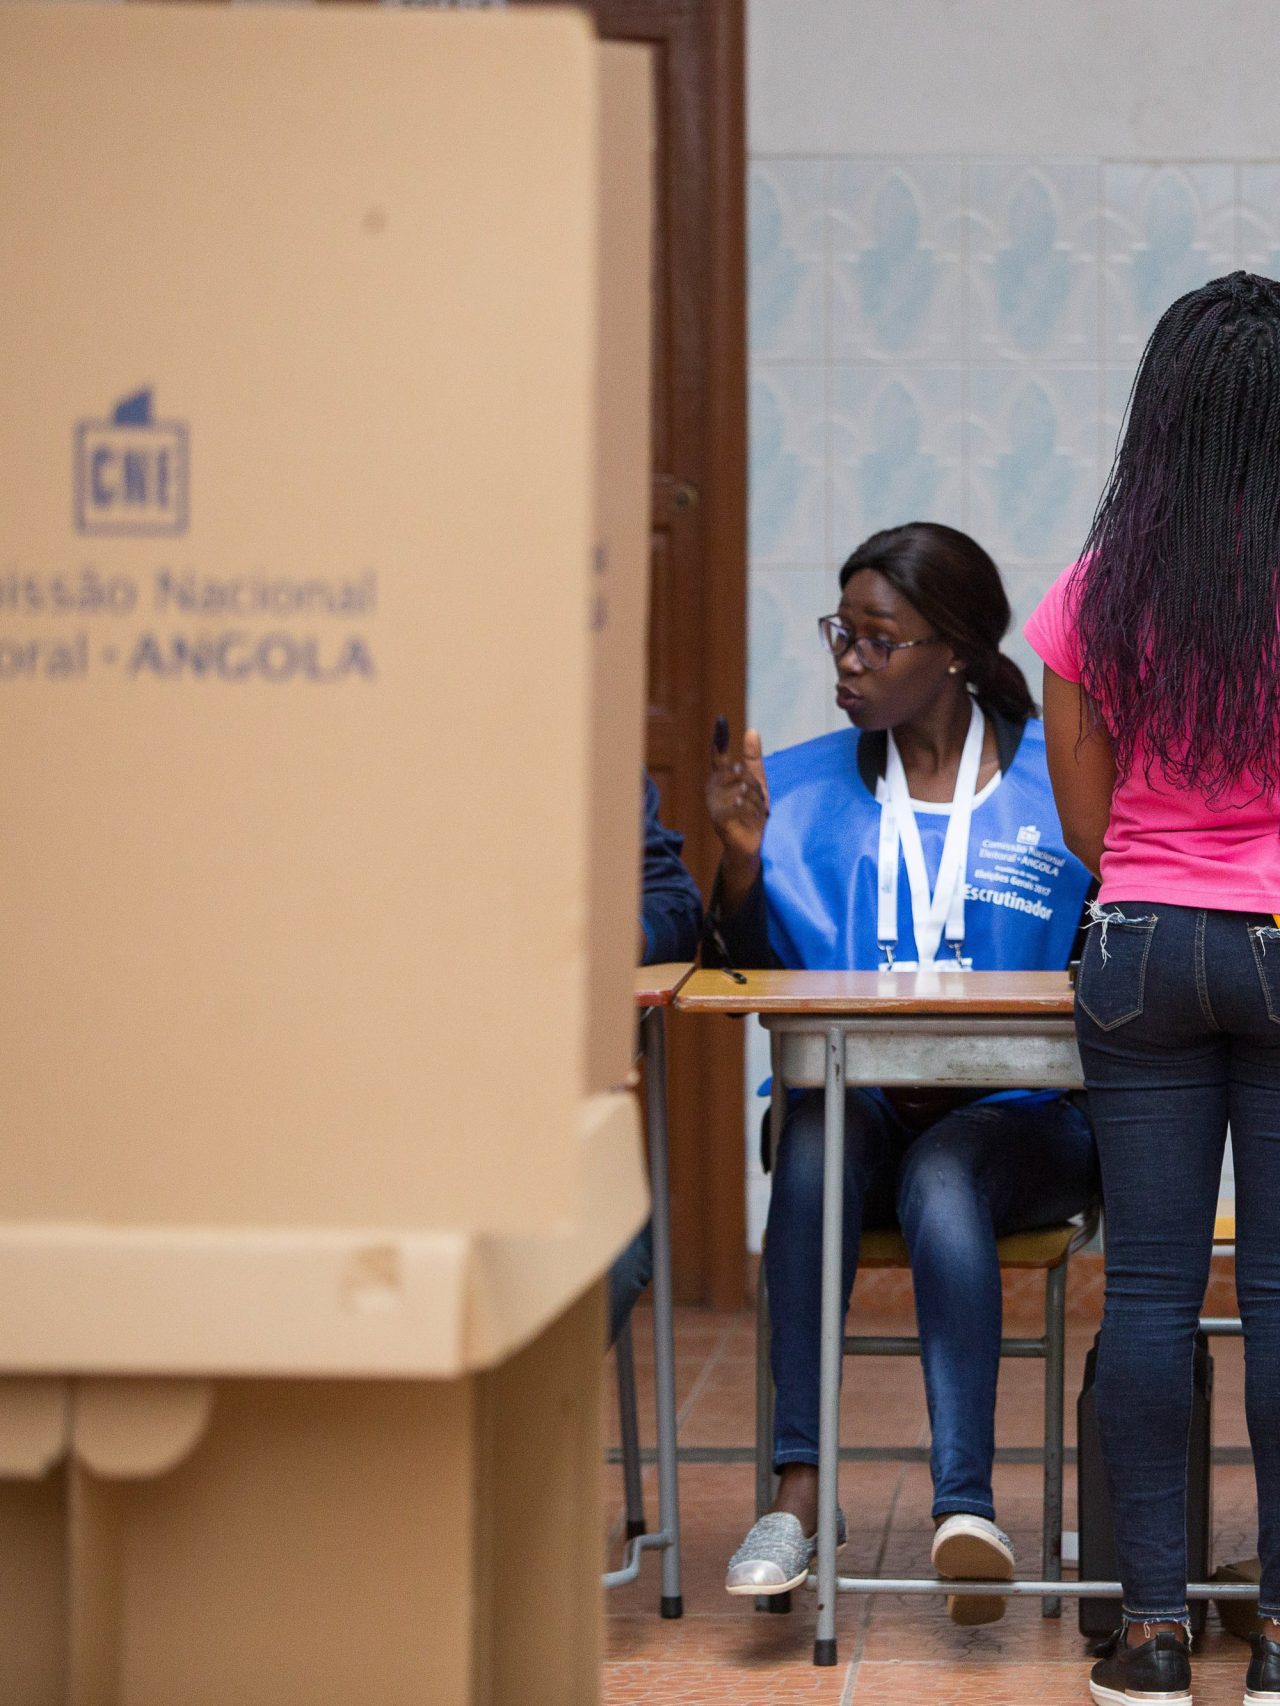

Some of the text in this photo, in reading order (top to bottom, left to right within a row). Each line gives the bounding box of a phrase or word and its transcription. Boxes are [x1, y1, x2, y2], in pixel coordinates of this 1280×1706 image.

[0, 566, 378, 615] issão Nacional
[129, 631, 375, 682] ANGOLA
[964, 883, 1054, 921] Escrutinador
